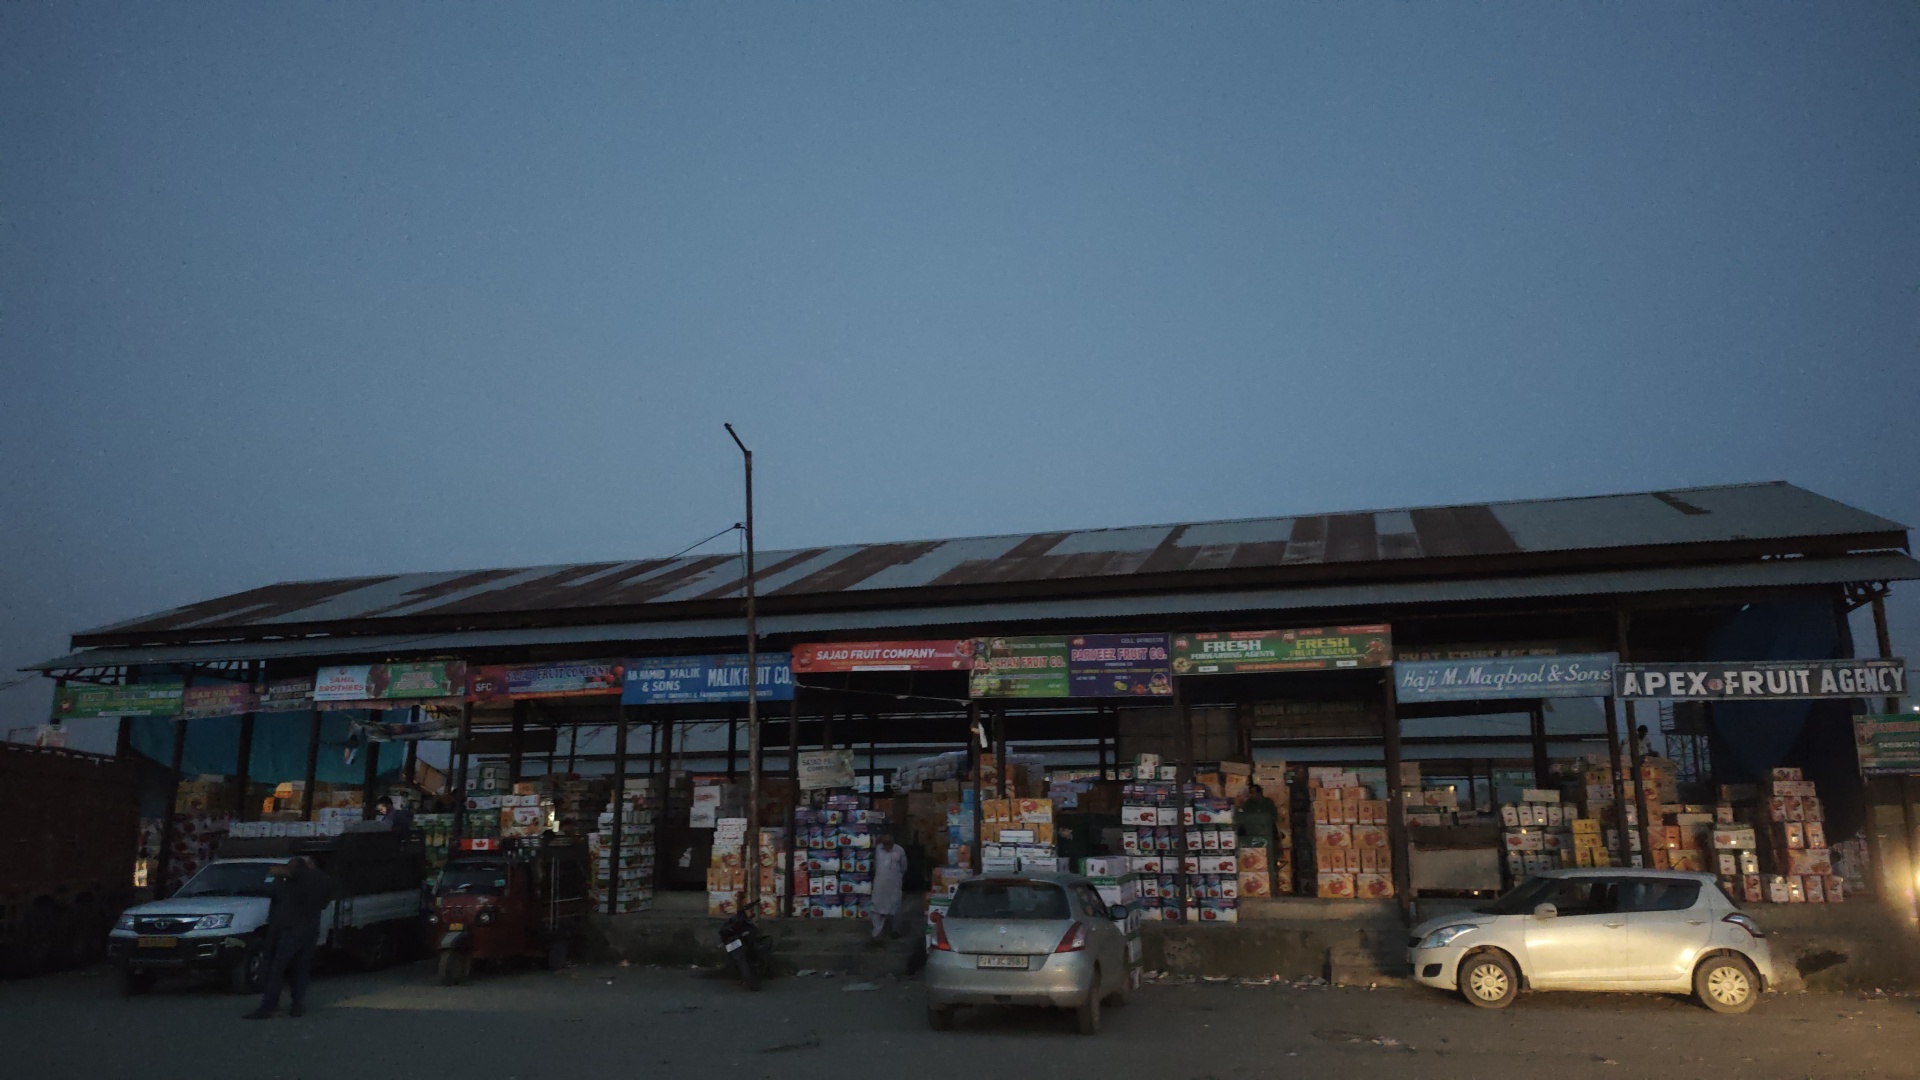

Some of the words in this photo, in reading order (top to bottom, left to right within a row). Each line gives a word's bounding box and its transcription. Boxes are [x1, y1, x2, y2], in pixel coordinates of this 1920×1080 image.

[1203, 640, 1261, 652] FRESH
[1296, 637, 1350, 649] FRESH
[817, 650, 848, 660] SAJAD
[850, 649, 881, 659] FRUIT
[882, 648, 935, 659] COMPANY
[1117, 647, 1147, 660] FRUIT
[1021, 656, 1048, 668] FRUIT
[536, 667, 565, 680] FRUIT
[669, 667, 700, 678] MALIK
[708, 668, 741, 687] MALIK
[774, 666, 792, 685] CO.
[1402, 670, 1438, 692] Haji
[1465, 664, 1547, 690] Maqbool
[1548, 664, 1565, 682] &
[1565, 663, 1611, 681] Sons
[475, 683, 493, 691] SFC
[653, 681, 681, 691] SONS
[1623, 671, 1708, 696] APEX
[1723, 670, 1811, 695] FRUIT
[1820, 667, 1905, 694] AGENCY
